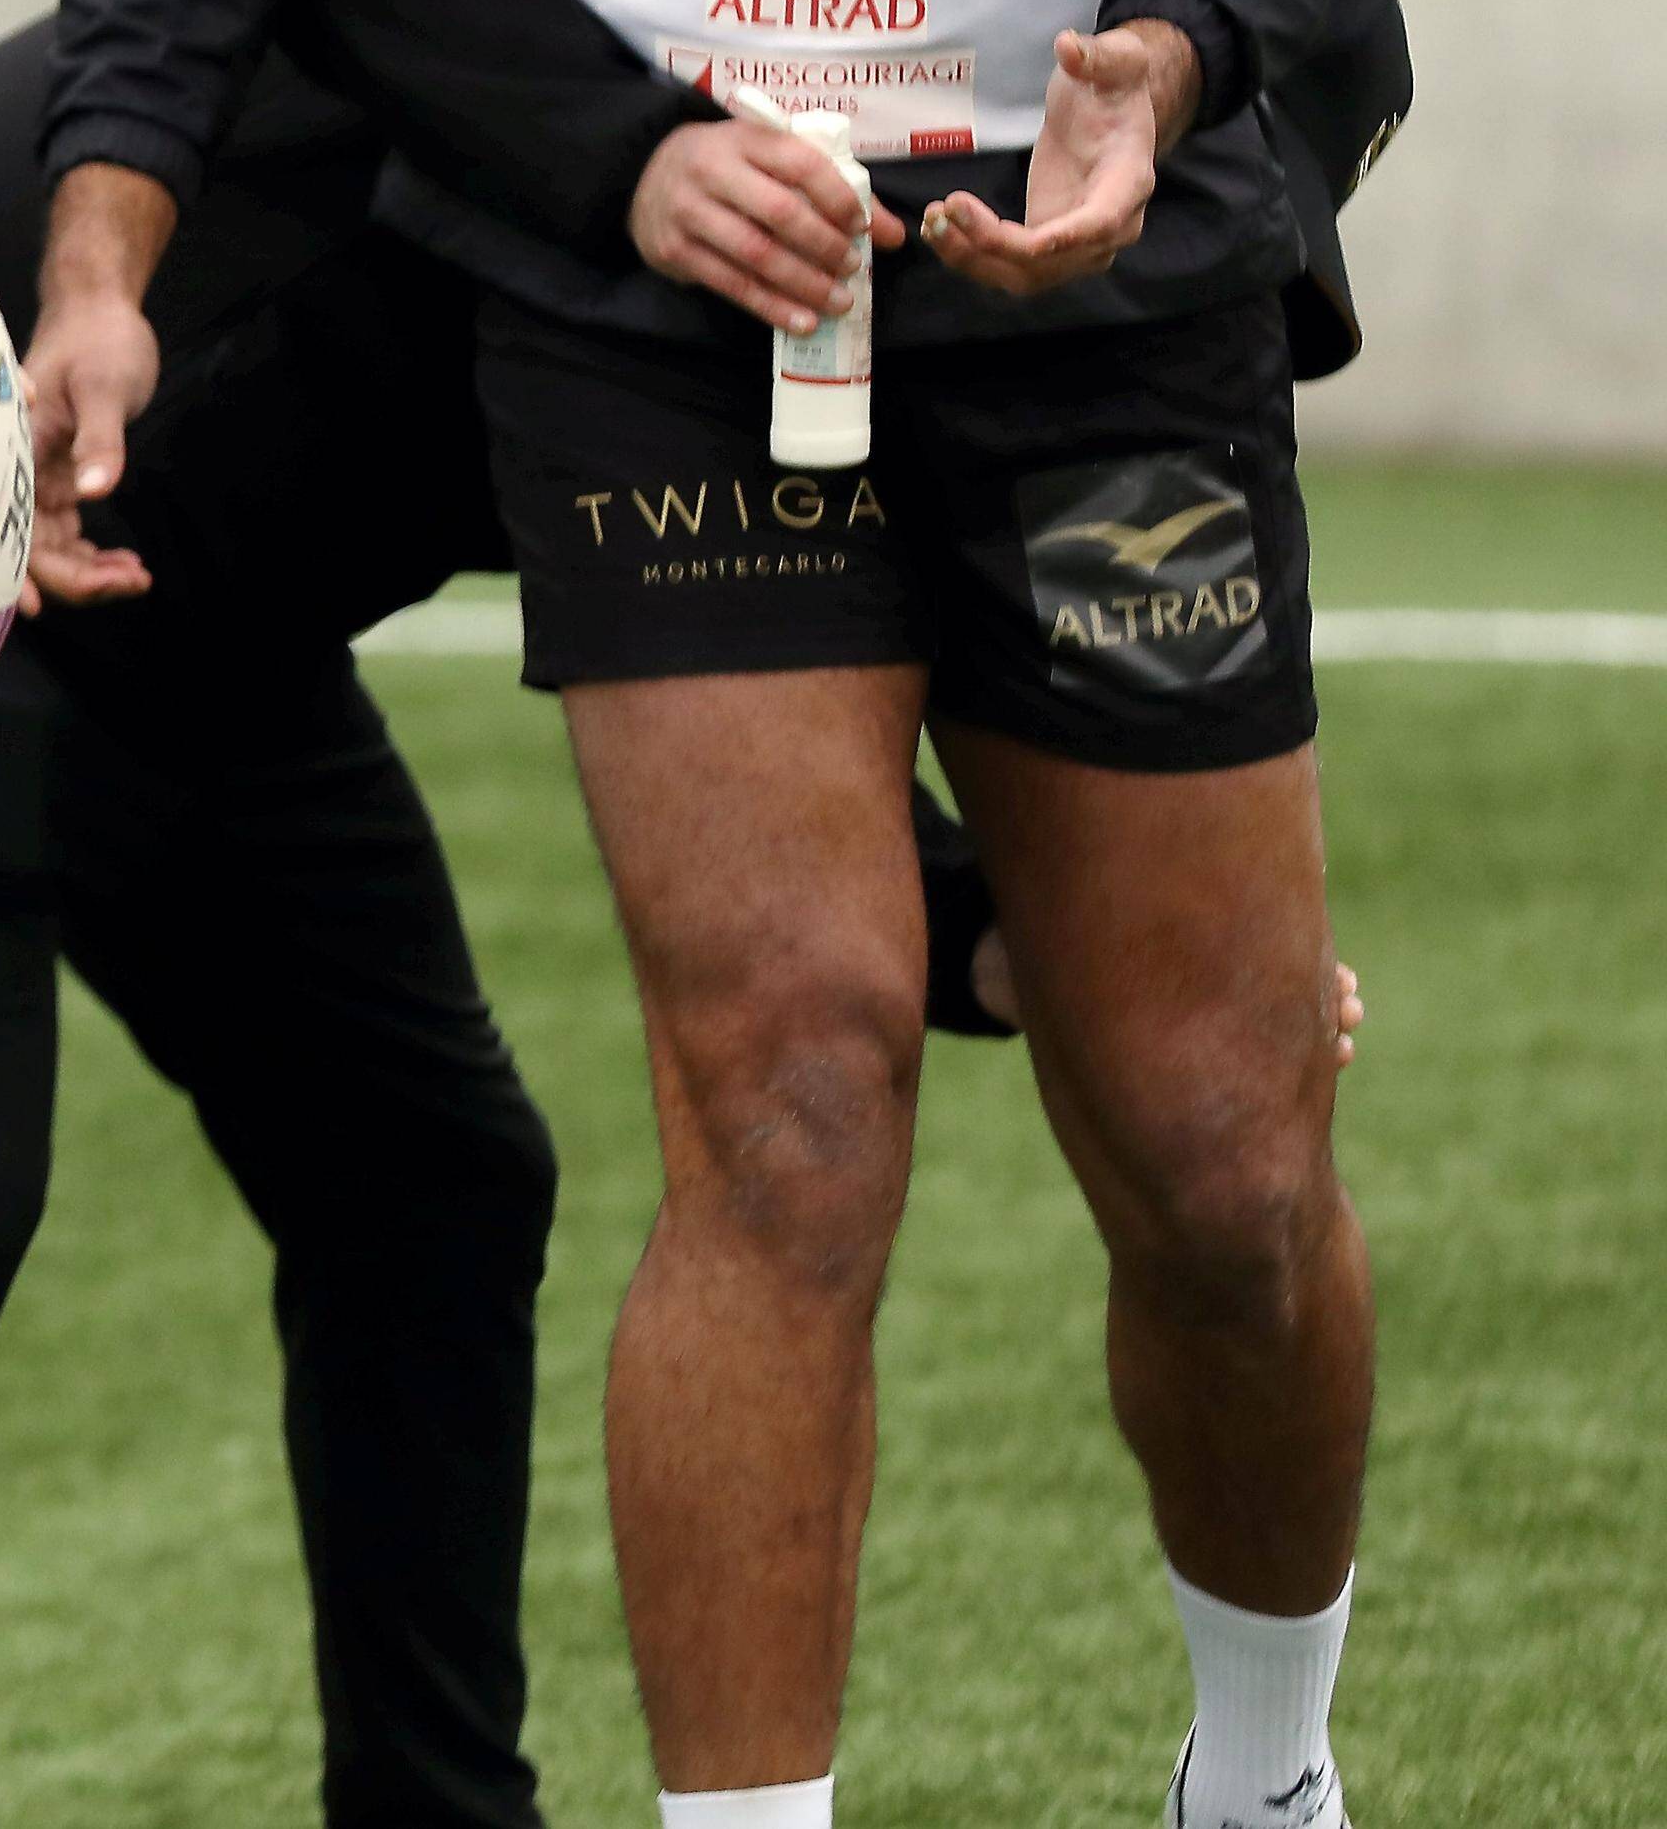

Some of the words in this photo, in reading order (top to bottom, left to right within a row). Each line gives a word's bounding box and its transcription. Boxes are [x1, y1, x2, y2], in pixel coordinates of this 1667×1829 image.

[574, 476, 888, 547] TWIGA
[641, 551, 847, 586] MONTECARLO
[1049, 574, 1263, 651] ALTRAD
